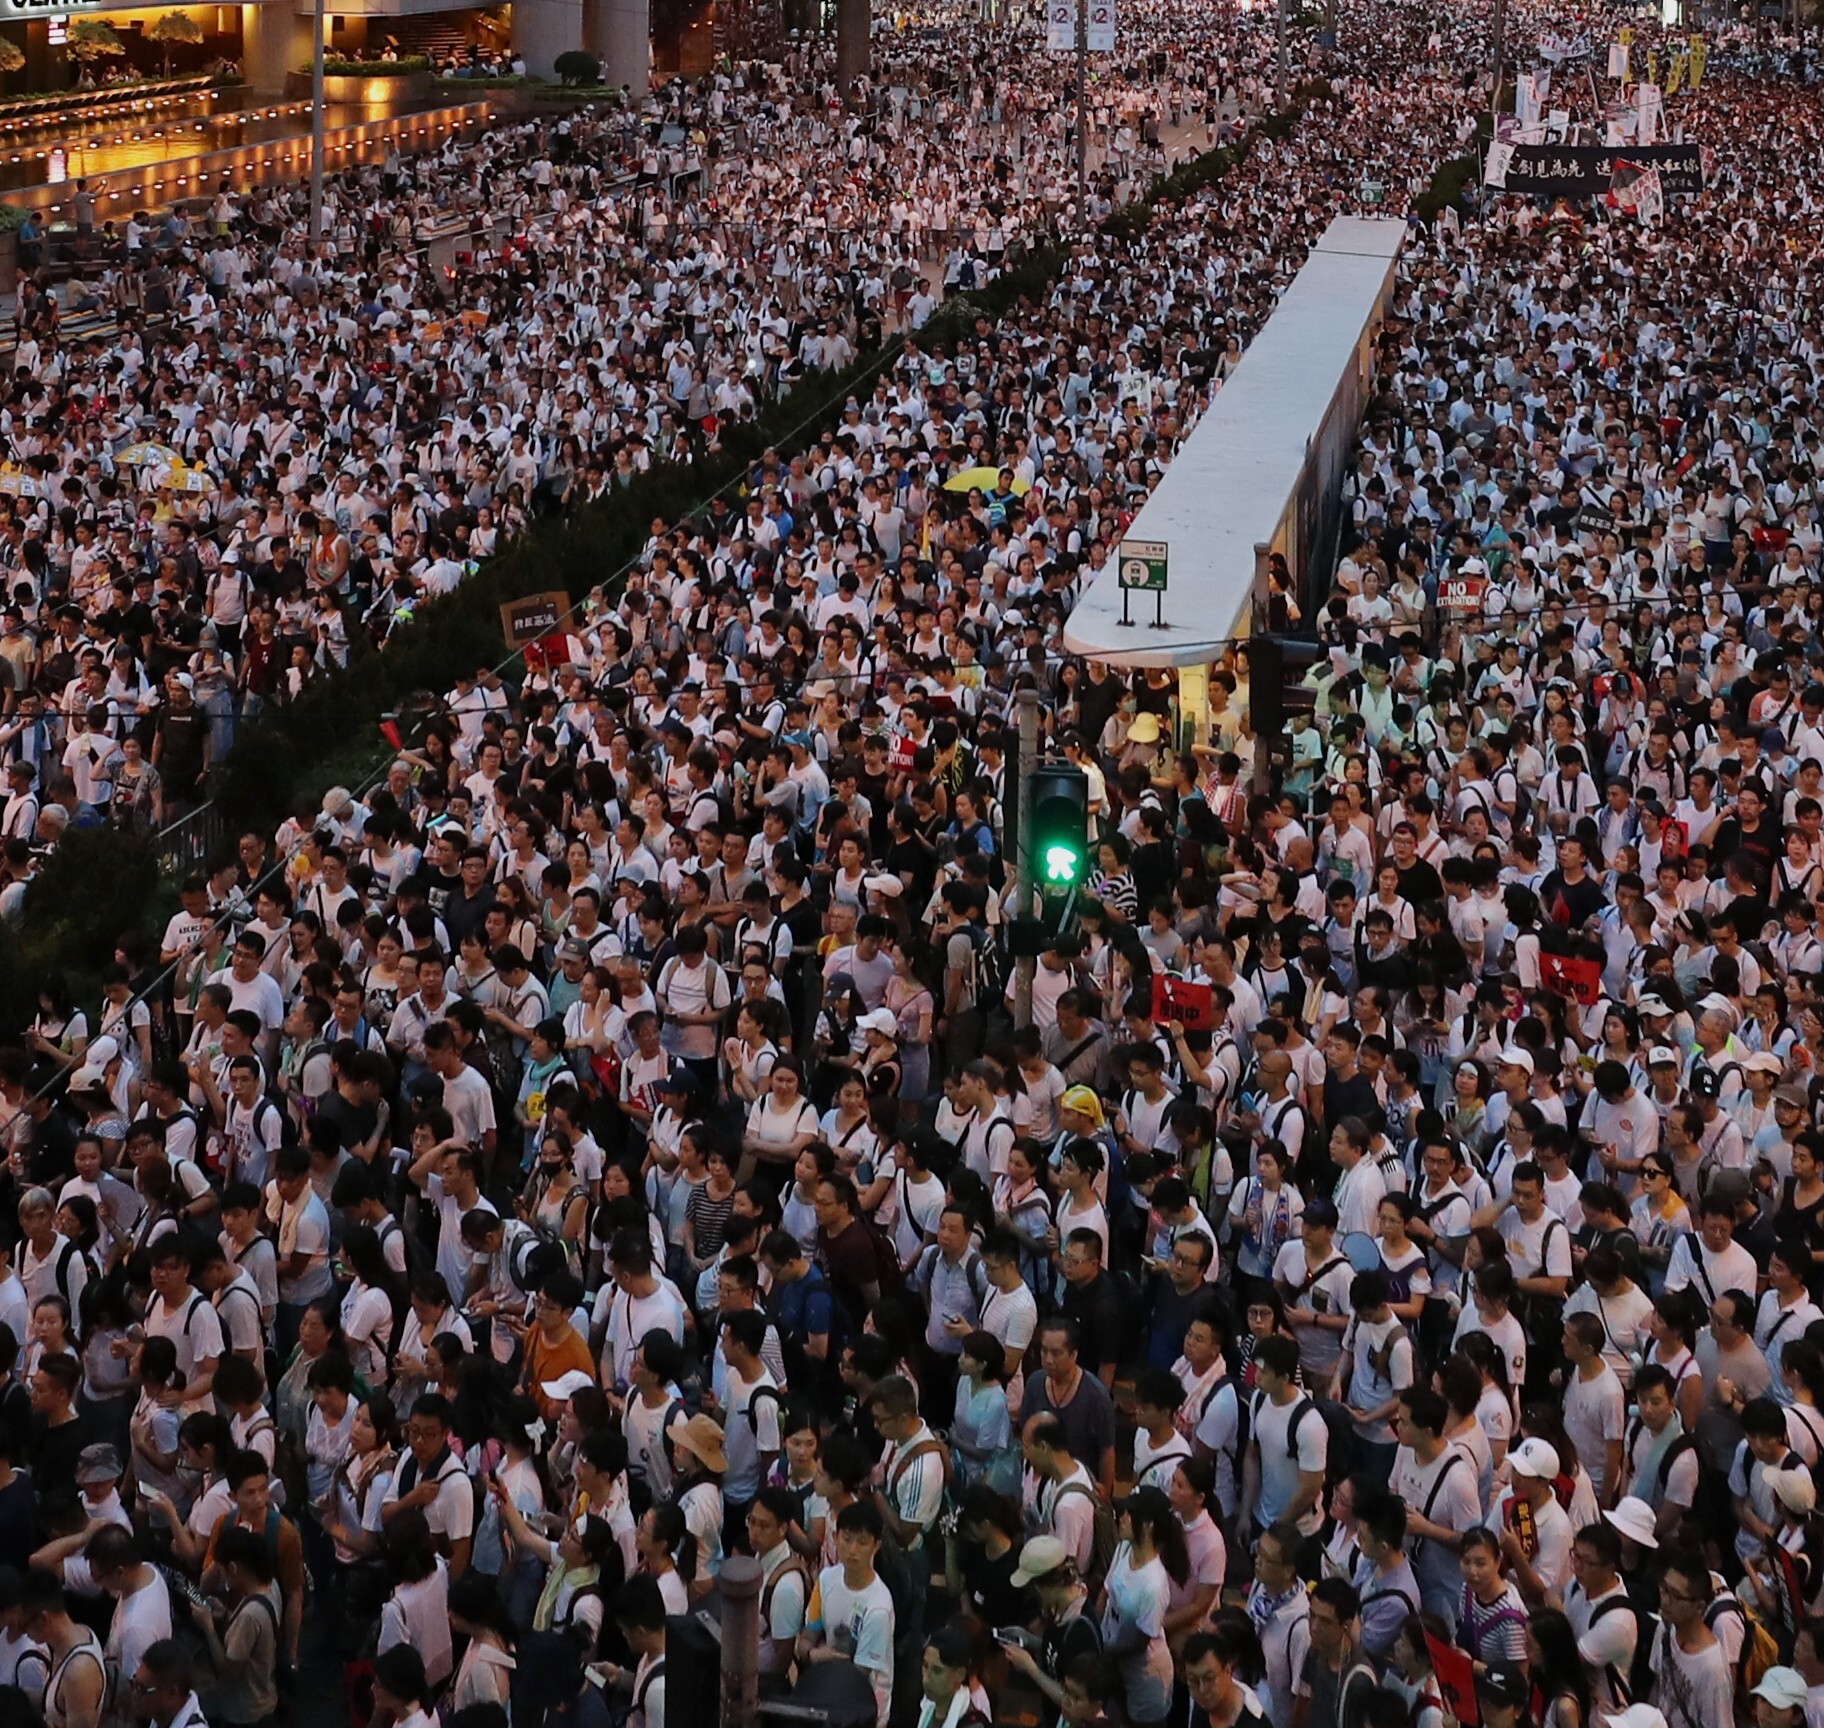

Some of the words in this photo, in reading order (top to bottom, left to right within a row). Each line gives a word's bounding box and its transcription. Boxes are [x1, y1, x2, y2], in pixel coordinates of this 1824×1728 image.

[1447, 581, 1467, 596] NO
[1159, 998, 1200, 1023] 反送中
